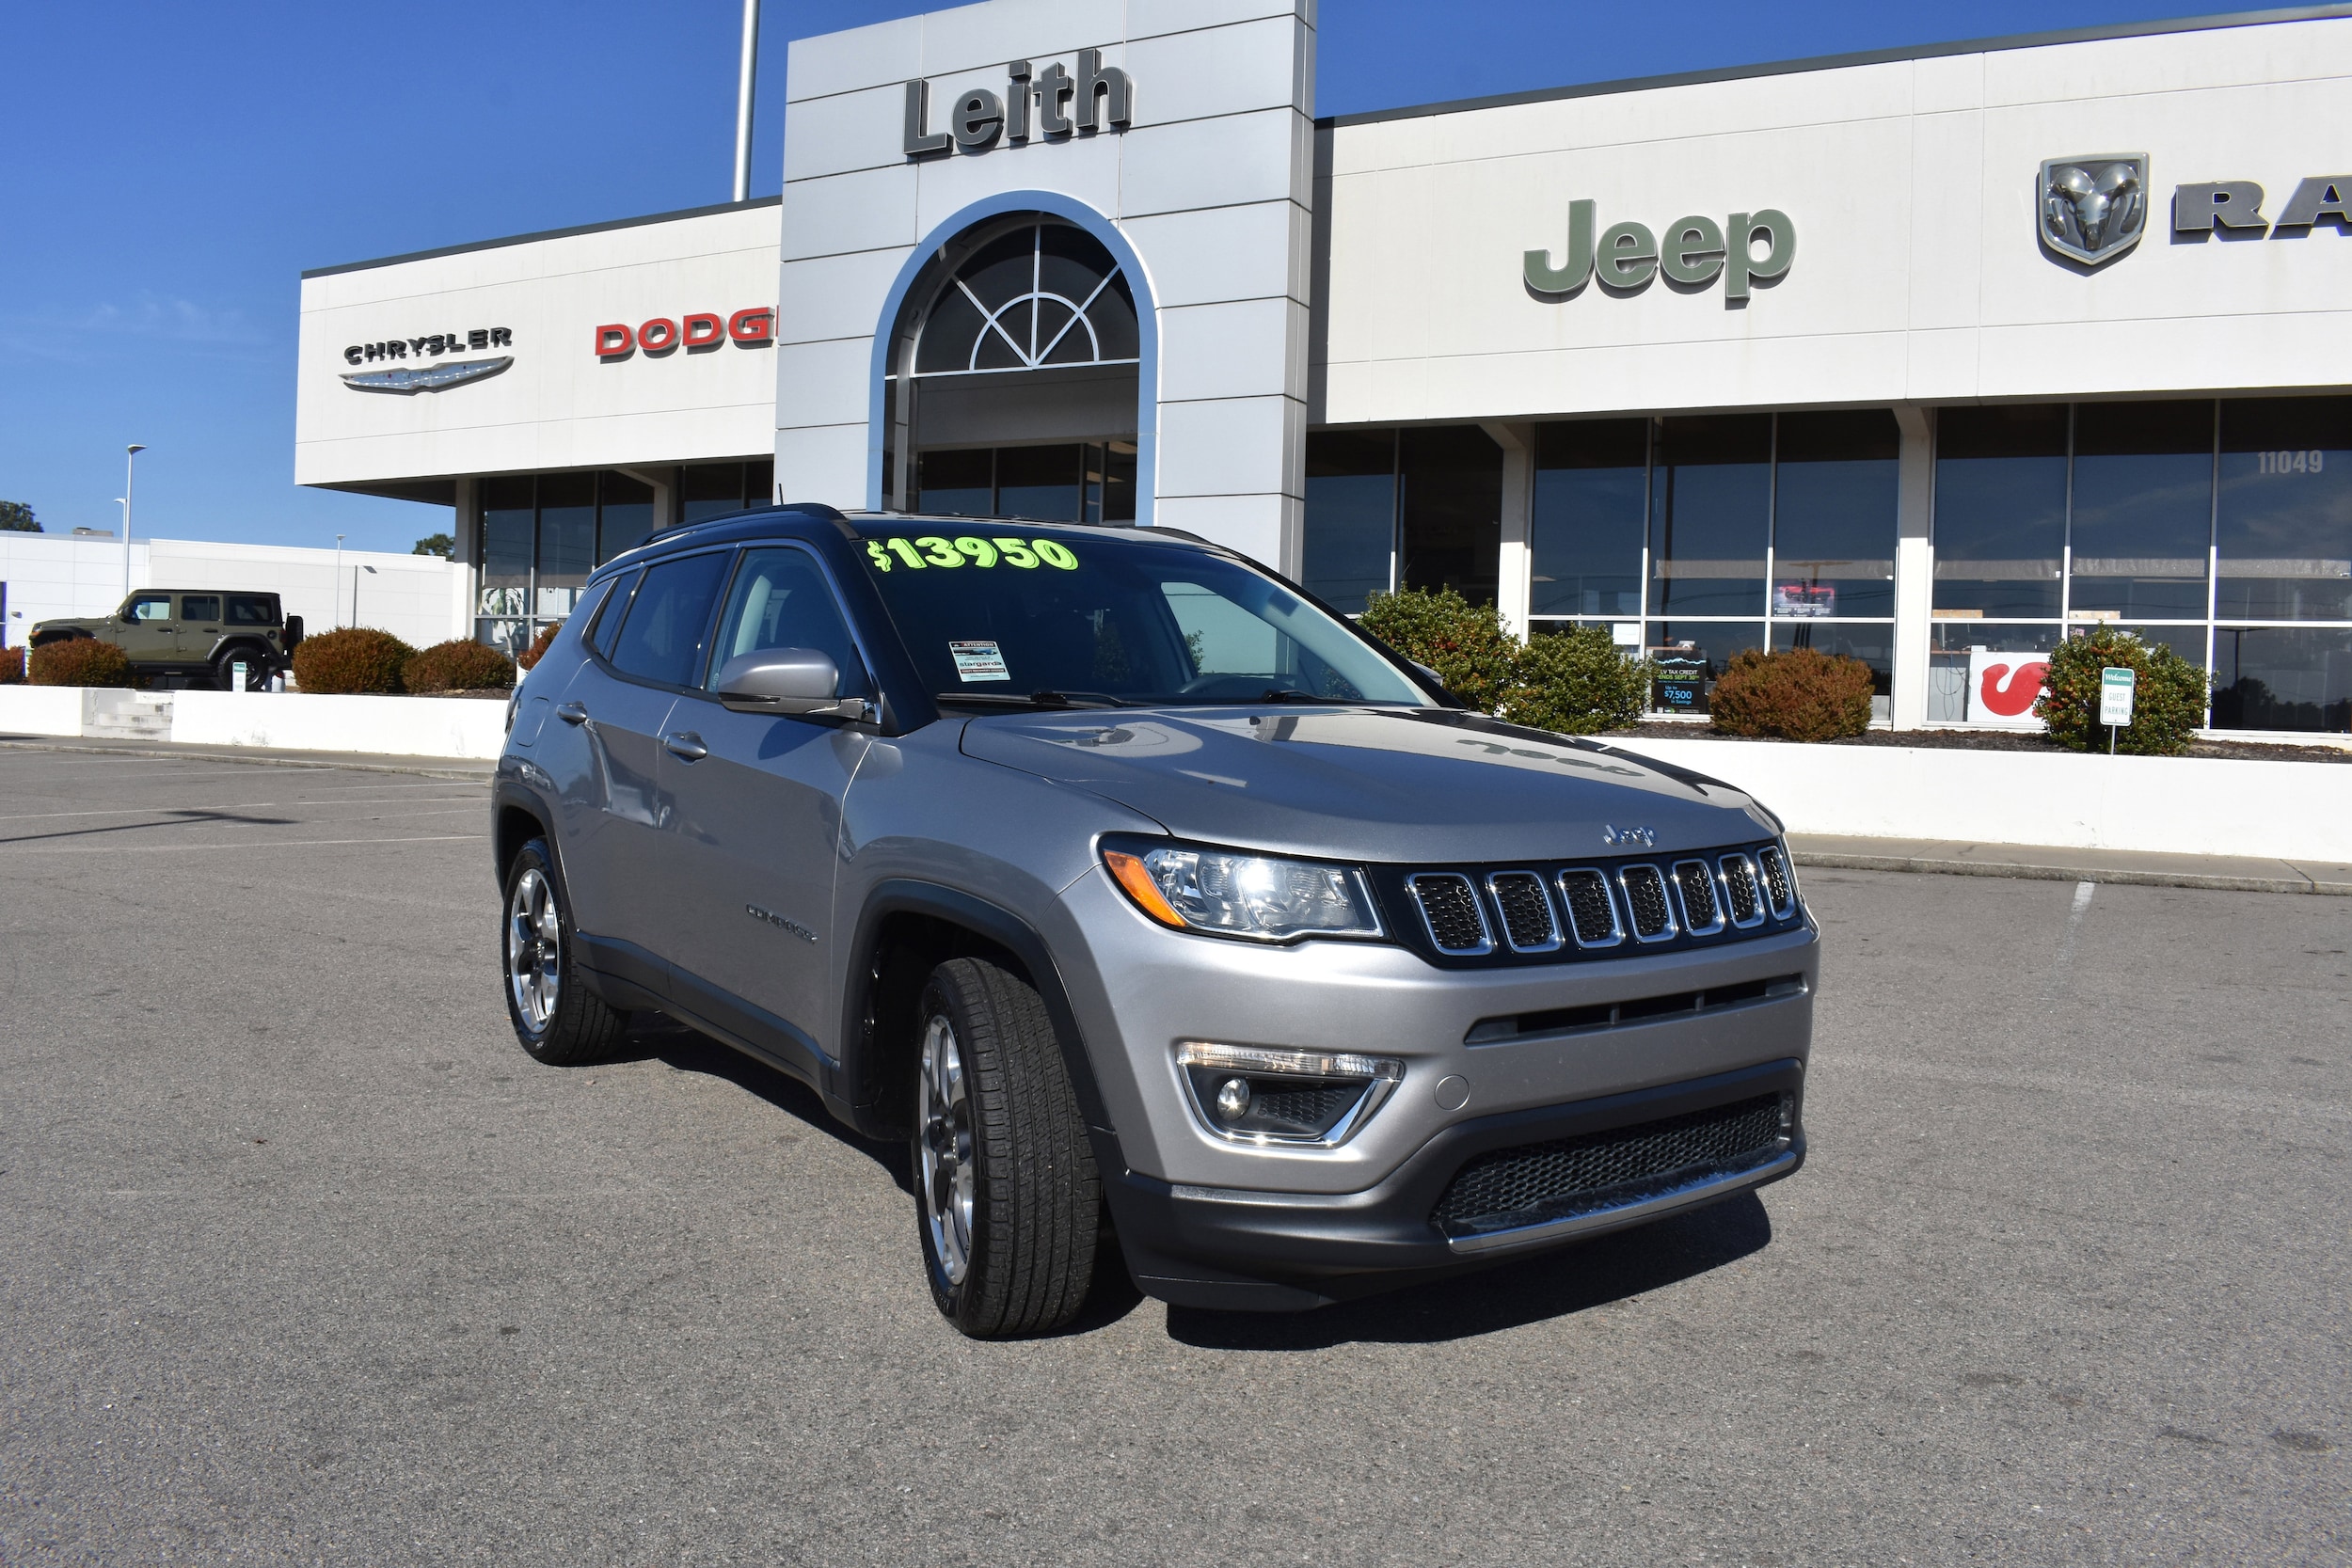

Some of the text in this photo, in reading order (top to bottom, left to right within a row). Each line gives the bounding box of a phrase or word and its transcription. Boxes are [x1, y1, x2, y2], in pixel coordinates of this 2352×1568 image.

[903, 48, 1133, 156] Leith
[1522, 198, 1797, 302] Jeep
[595, 304, 780, 358] DODG
[343, 326, 513, 365] CHRYSLER
[2258, 450, 2323, 474] 11049
[866, 536, 1079, 573] $13950
[2106, 673, 2132, 682] Welcome
[1664, 690, 1692, 700] $7,500
[2108, 692, 2125, 702] GUEST
[2105, 705, 2128, 716] PARKING
[1603, 824, 1657, 847] Jeep
